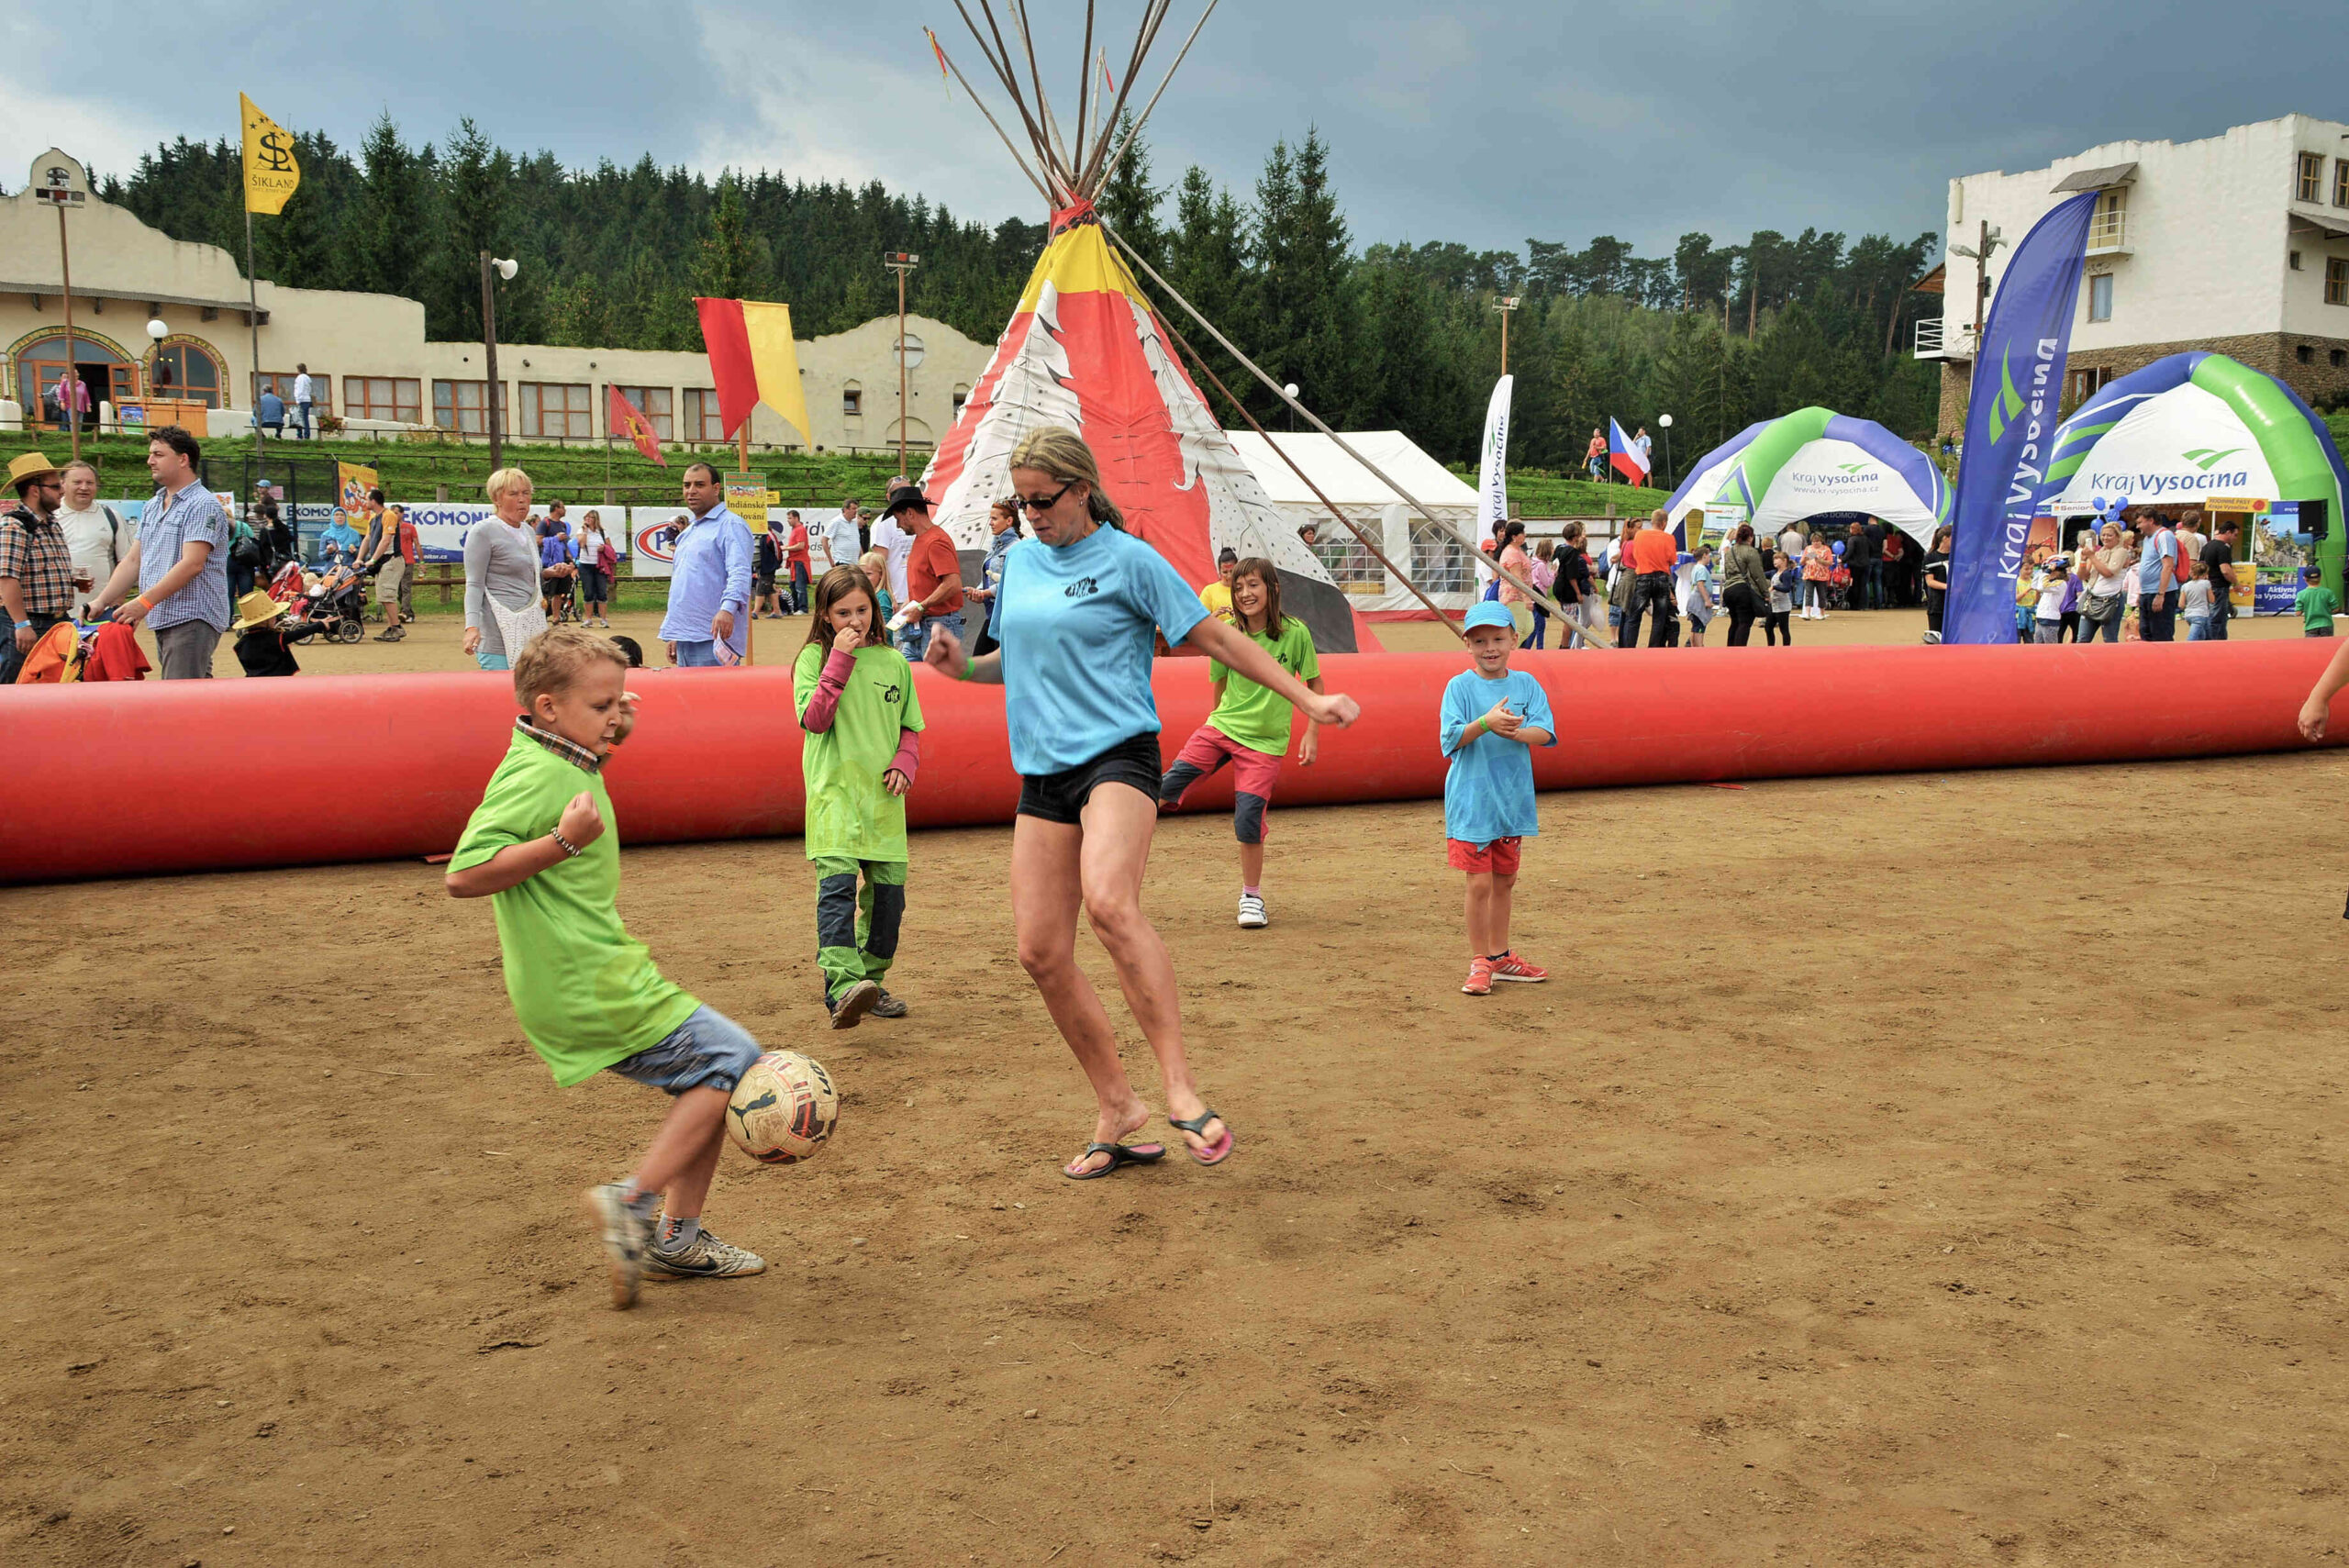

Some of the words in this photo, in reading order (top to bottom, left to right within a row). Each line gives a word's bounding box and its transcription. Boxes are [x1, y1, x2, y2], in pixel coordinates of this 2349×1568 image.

[1792, 472, 1817, 485] Kraj
[2091, 473, 2135, 495] Kraj
[727, 500, 765, 509] Indiánské
[286, 505, 333, 517] EKOMO
[738, 511, 765, 520] lování
